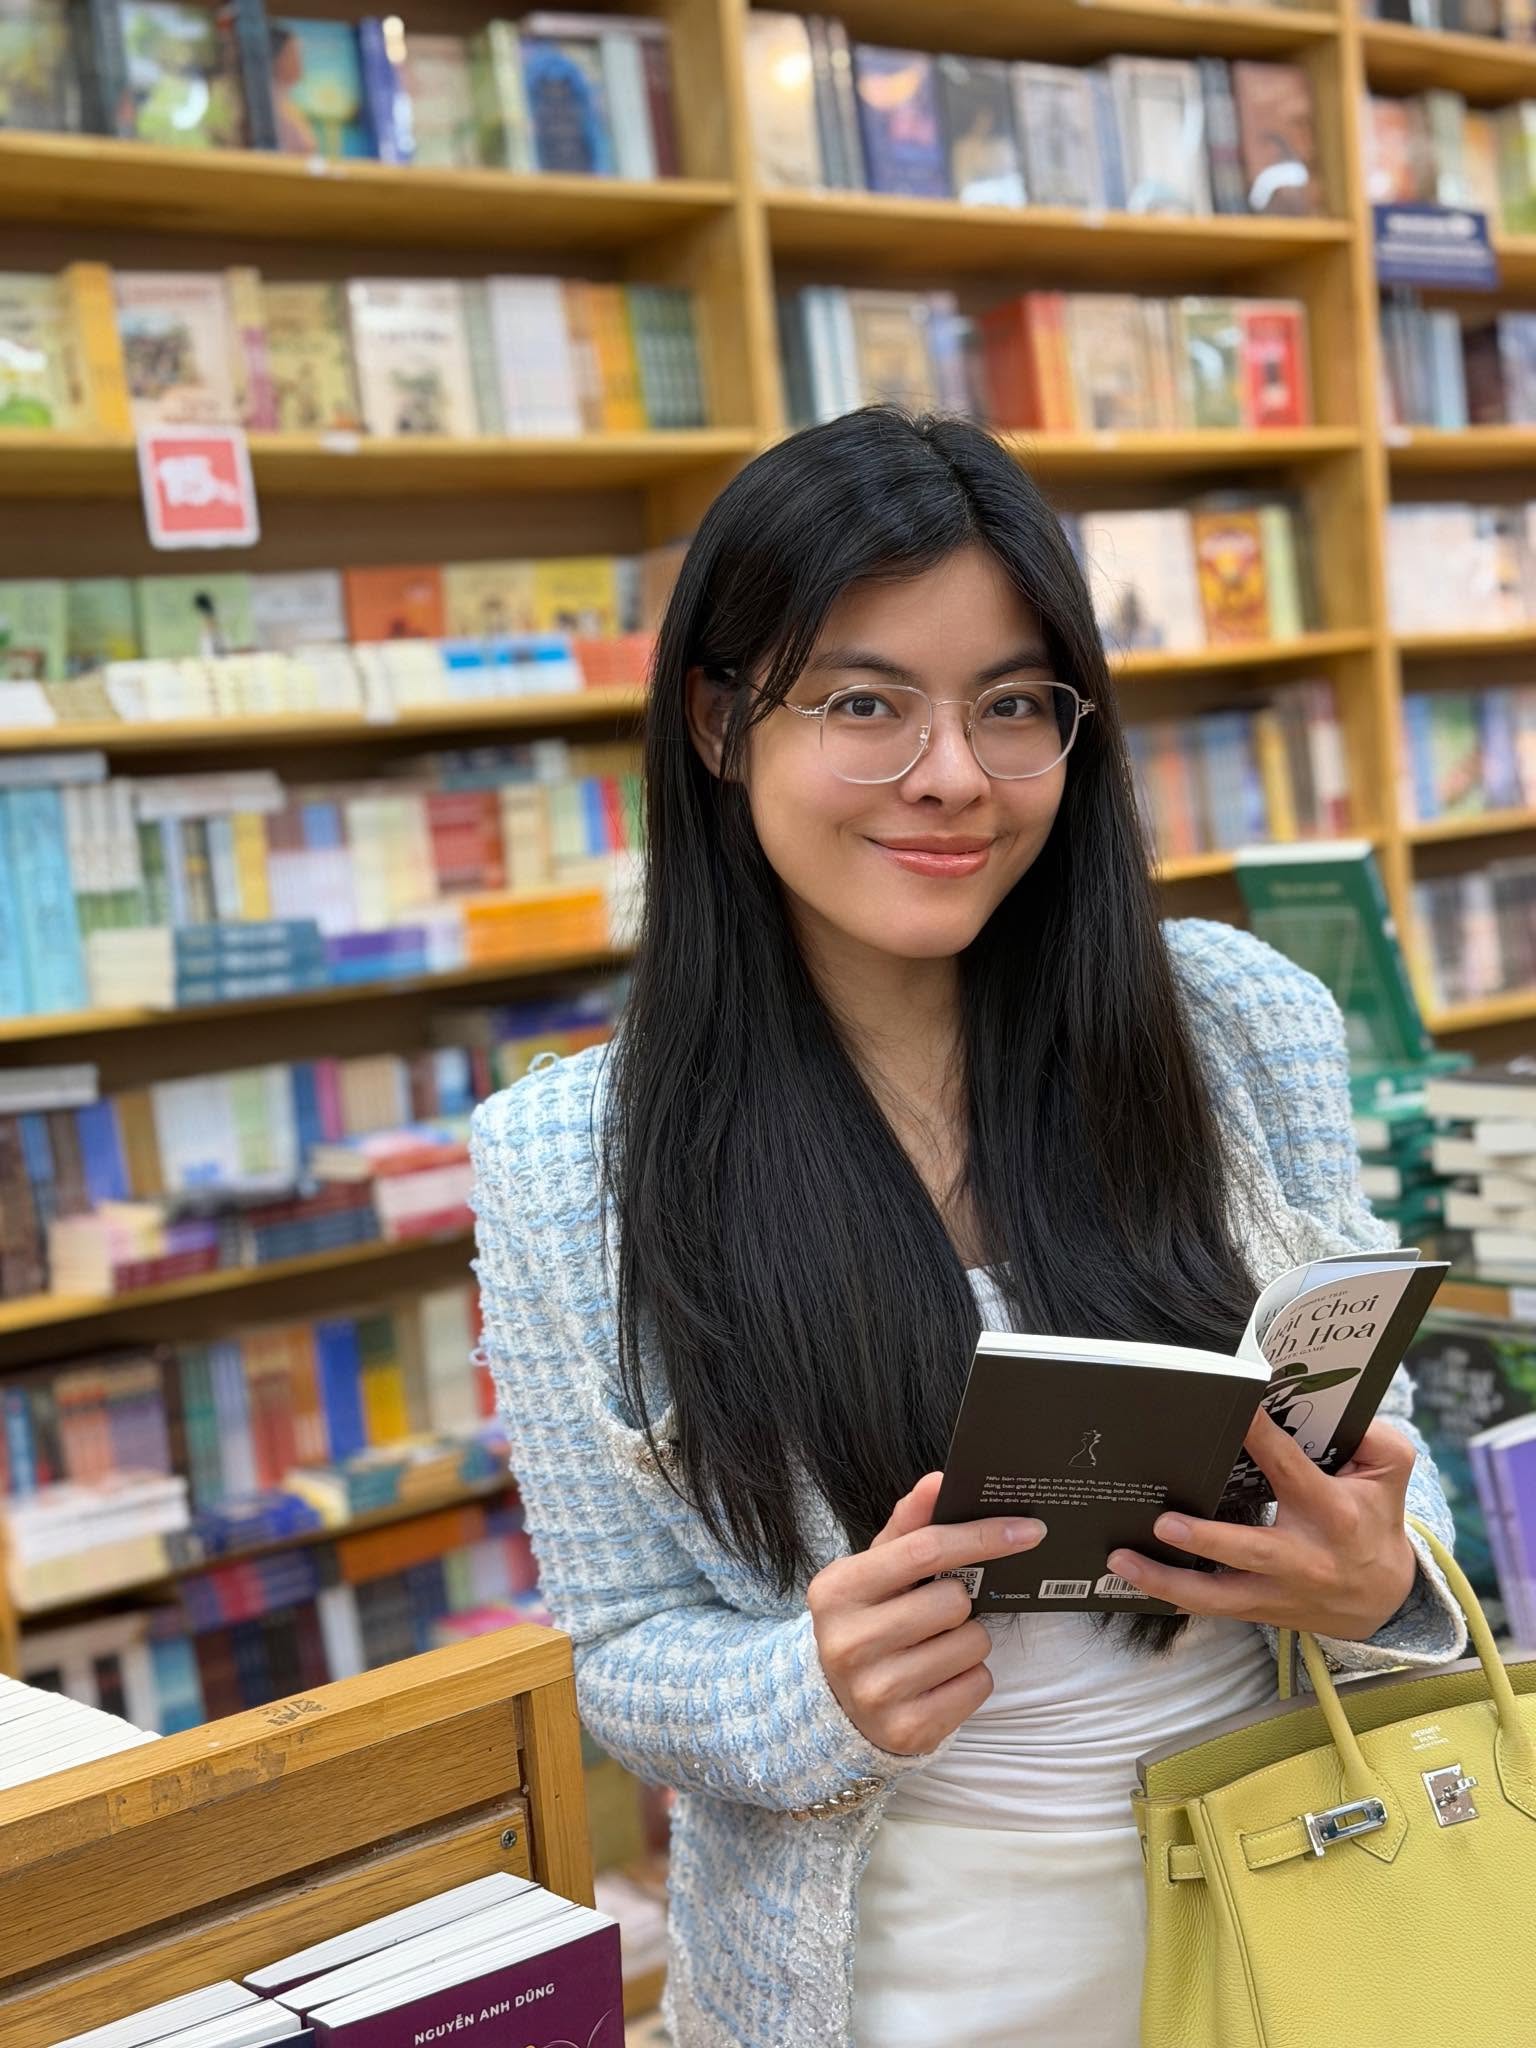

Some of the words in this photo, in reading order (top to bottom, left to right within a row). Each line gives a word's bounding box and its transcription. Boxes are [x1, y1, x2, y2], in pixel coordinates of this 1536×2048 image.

[1311, 1294, 1380, 1322] Chơi
[1305, 1322, 1377, 1347] Hoa
[414, 2013, 475, 2046] NGUYỄN
[479, 1999, 511, 2022] ANH
[514, 1983, 556, 2008] DŨNG
